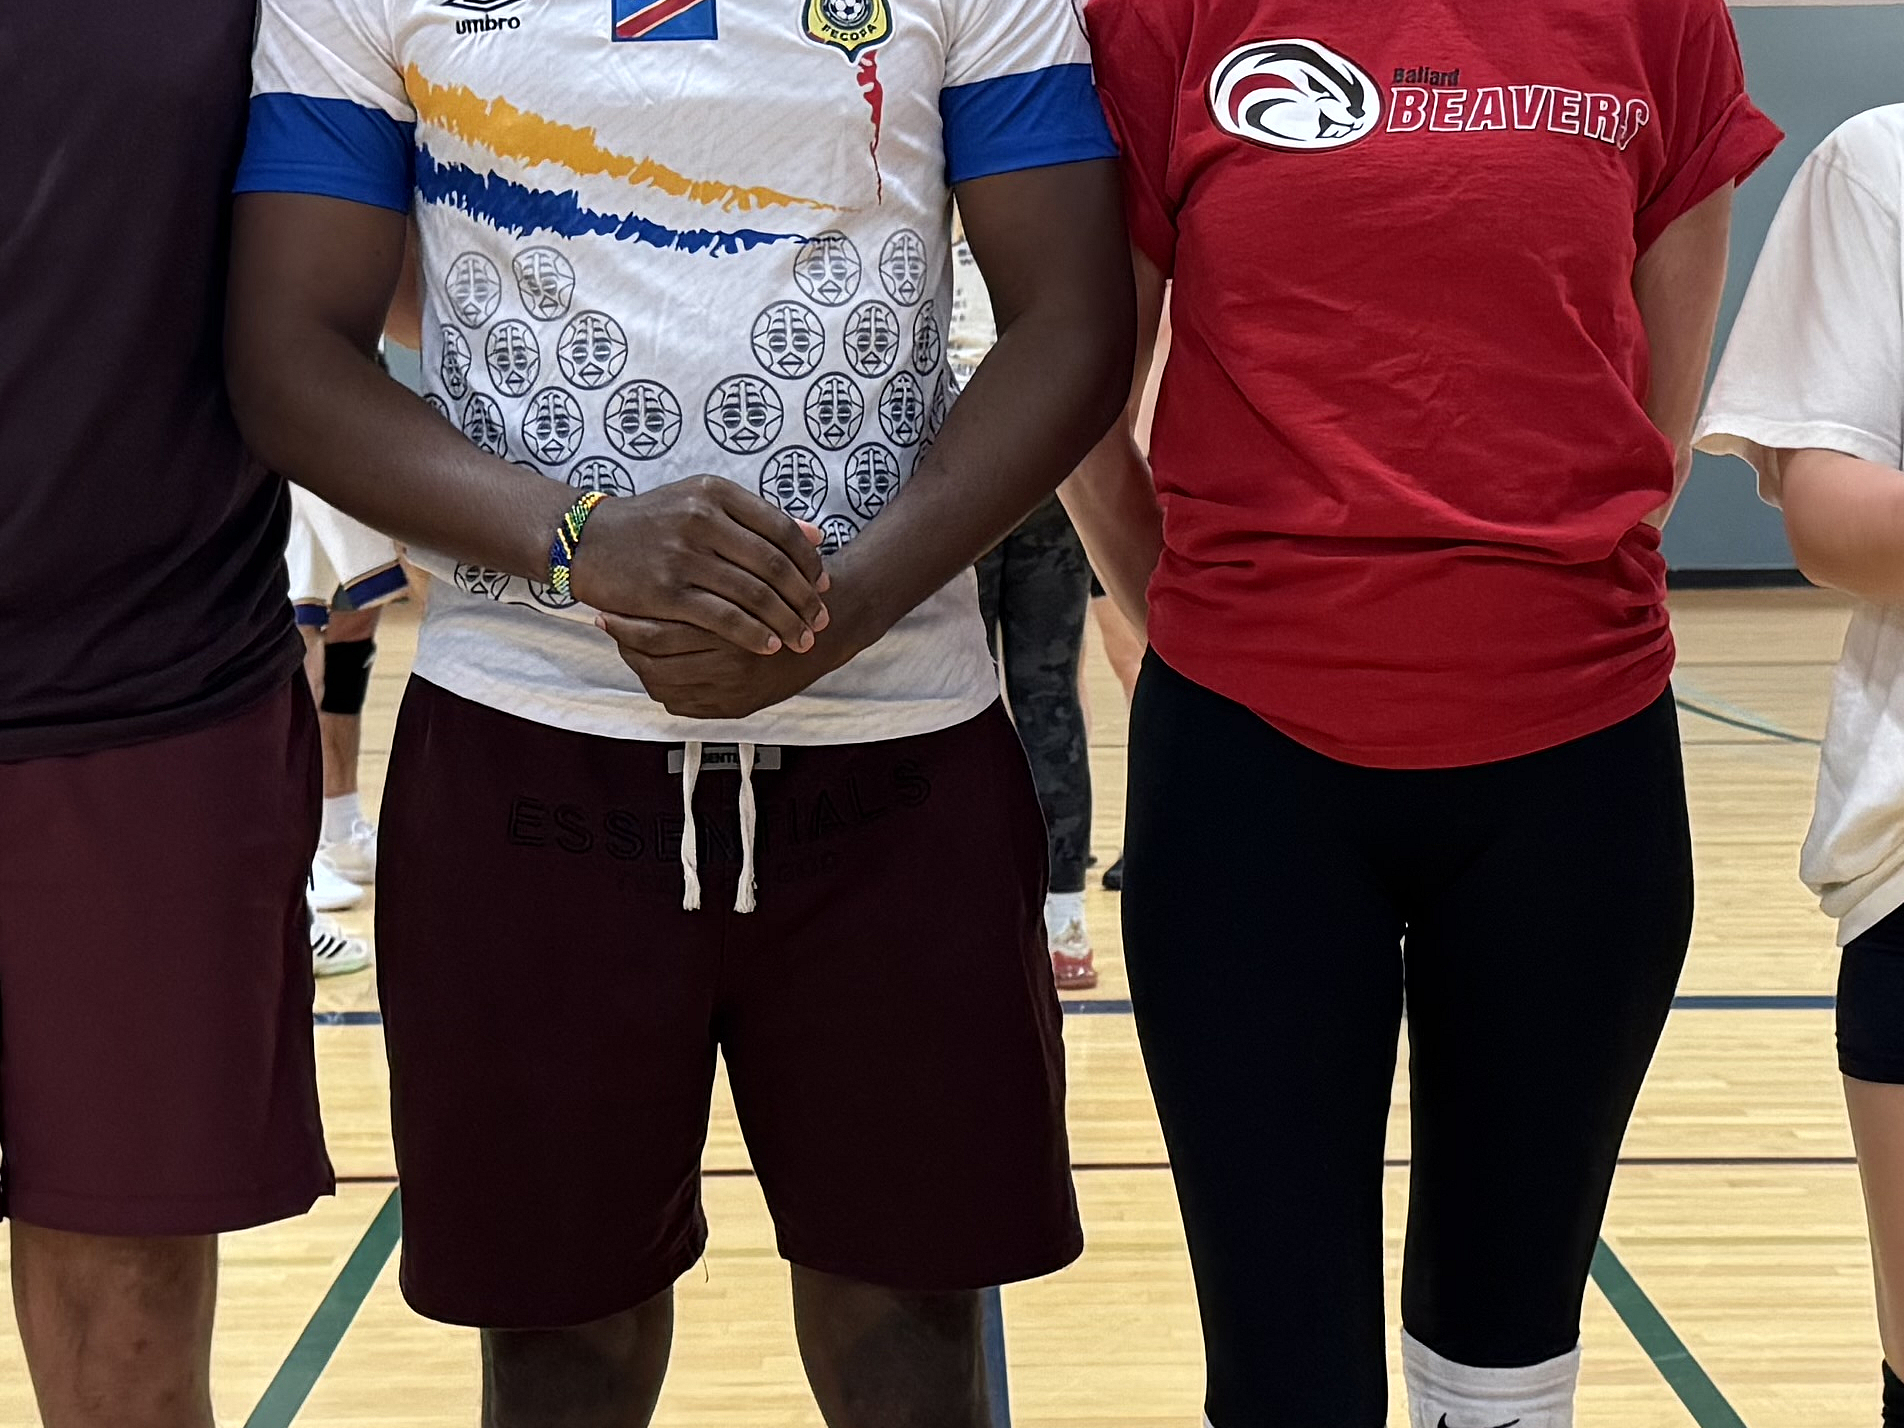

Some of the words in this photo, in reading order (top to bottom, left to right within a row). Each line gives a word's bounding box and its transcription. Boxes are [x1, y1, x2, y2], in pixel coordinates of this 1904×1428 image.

[456, 13, 521, 35] umbro
[1393, 66, 1460, 87] Ballard
[1386, 84, 1650, 151] BEAVERS
